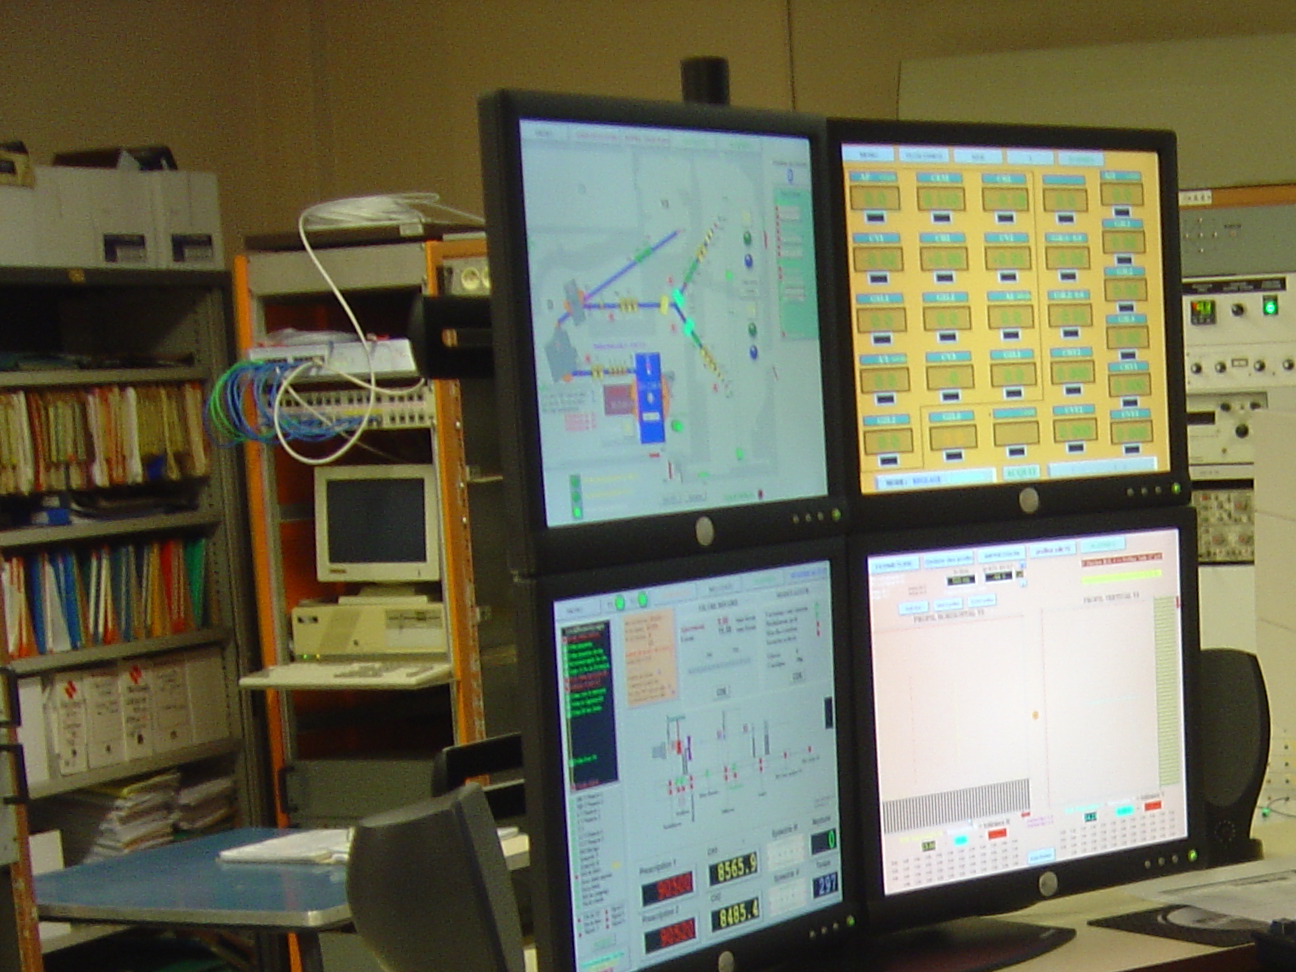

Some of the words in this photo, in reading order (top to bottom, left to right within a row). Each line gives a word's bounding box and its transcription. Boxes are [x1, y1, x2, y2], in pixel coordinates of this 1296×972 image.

[717, 853, 757, 882] 8565.9
[818, 874, 837, 895] 297
[719, 899, 758, 928] 8485.4
